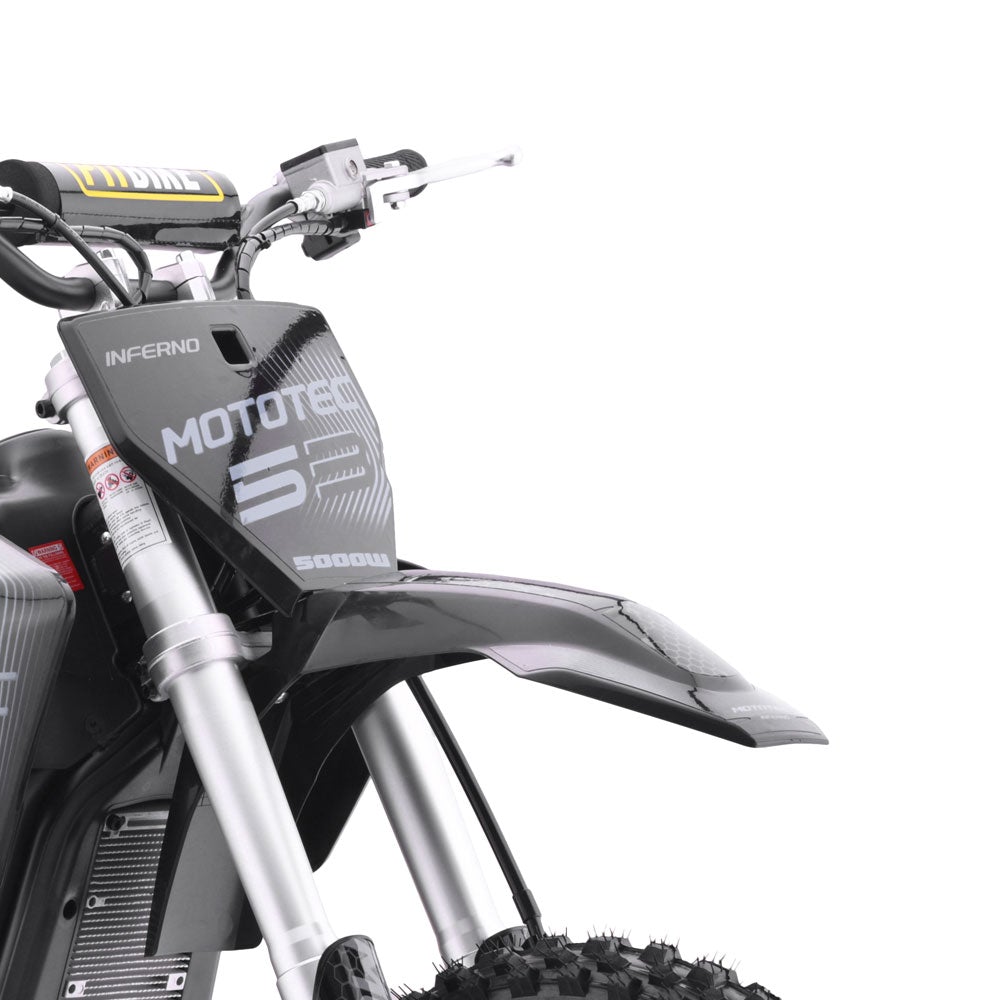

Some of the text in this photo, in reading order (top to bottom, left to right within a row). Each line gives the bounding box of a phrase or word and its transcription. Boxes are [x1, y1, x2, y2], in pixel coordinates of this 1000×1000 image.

[105, 338, 200, 367] INFERNO
[160, 375, 359, 465] MOTOTEC
[293, 552, 391, 570] 5000W
